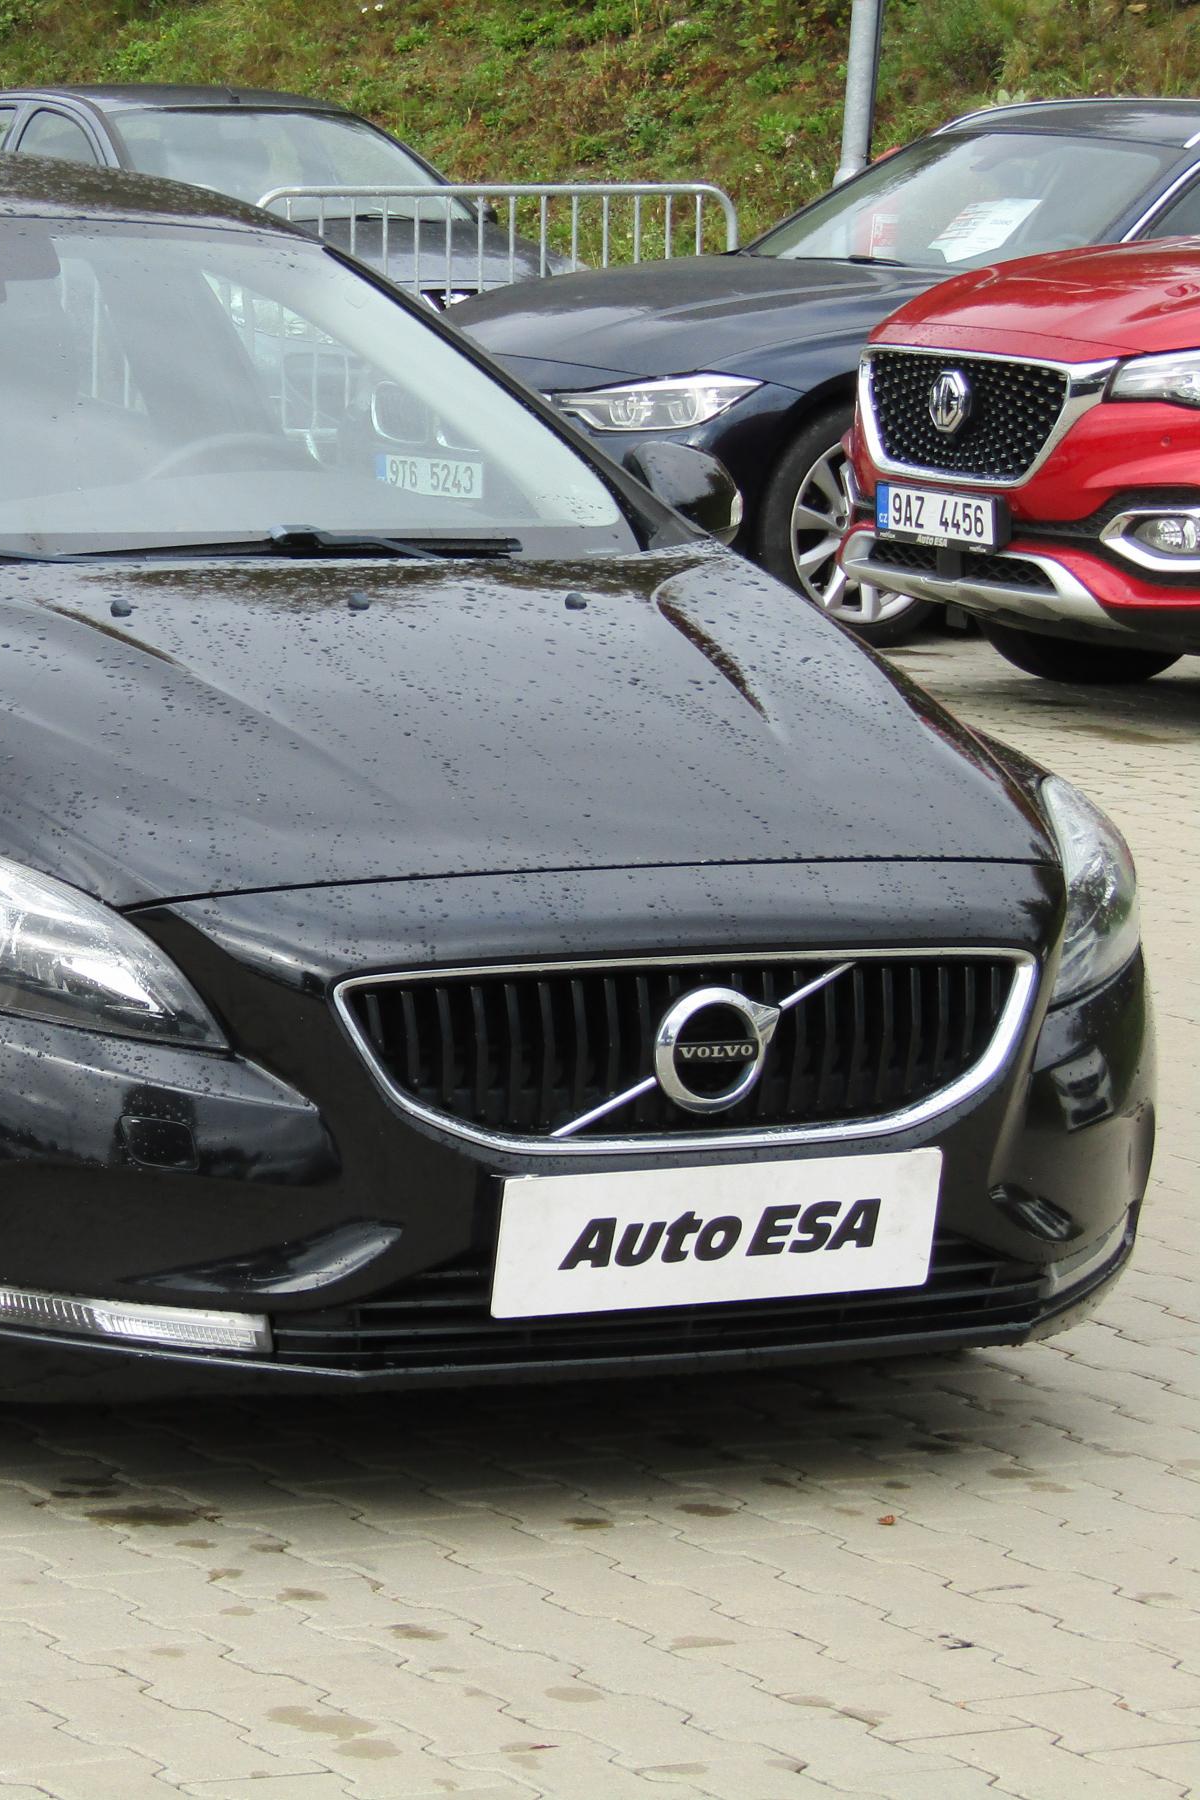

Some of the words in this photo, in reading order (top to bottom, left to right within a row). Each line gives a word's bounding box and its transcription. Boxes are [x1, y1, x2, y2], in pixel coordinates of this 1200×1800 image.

[390, 459, 418, 487] 9T6
[429, 462, 474, 494] 5243
[892, 493, 925, 529] 9AZ
[939, 499, 984, 538] 4456
[678, 1044, 754, 1059] VOLVO
[557, 1210, 743, 1271] Auto
[745, 1197, 882, 1258] ESA
